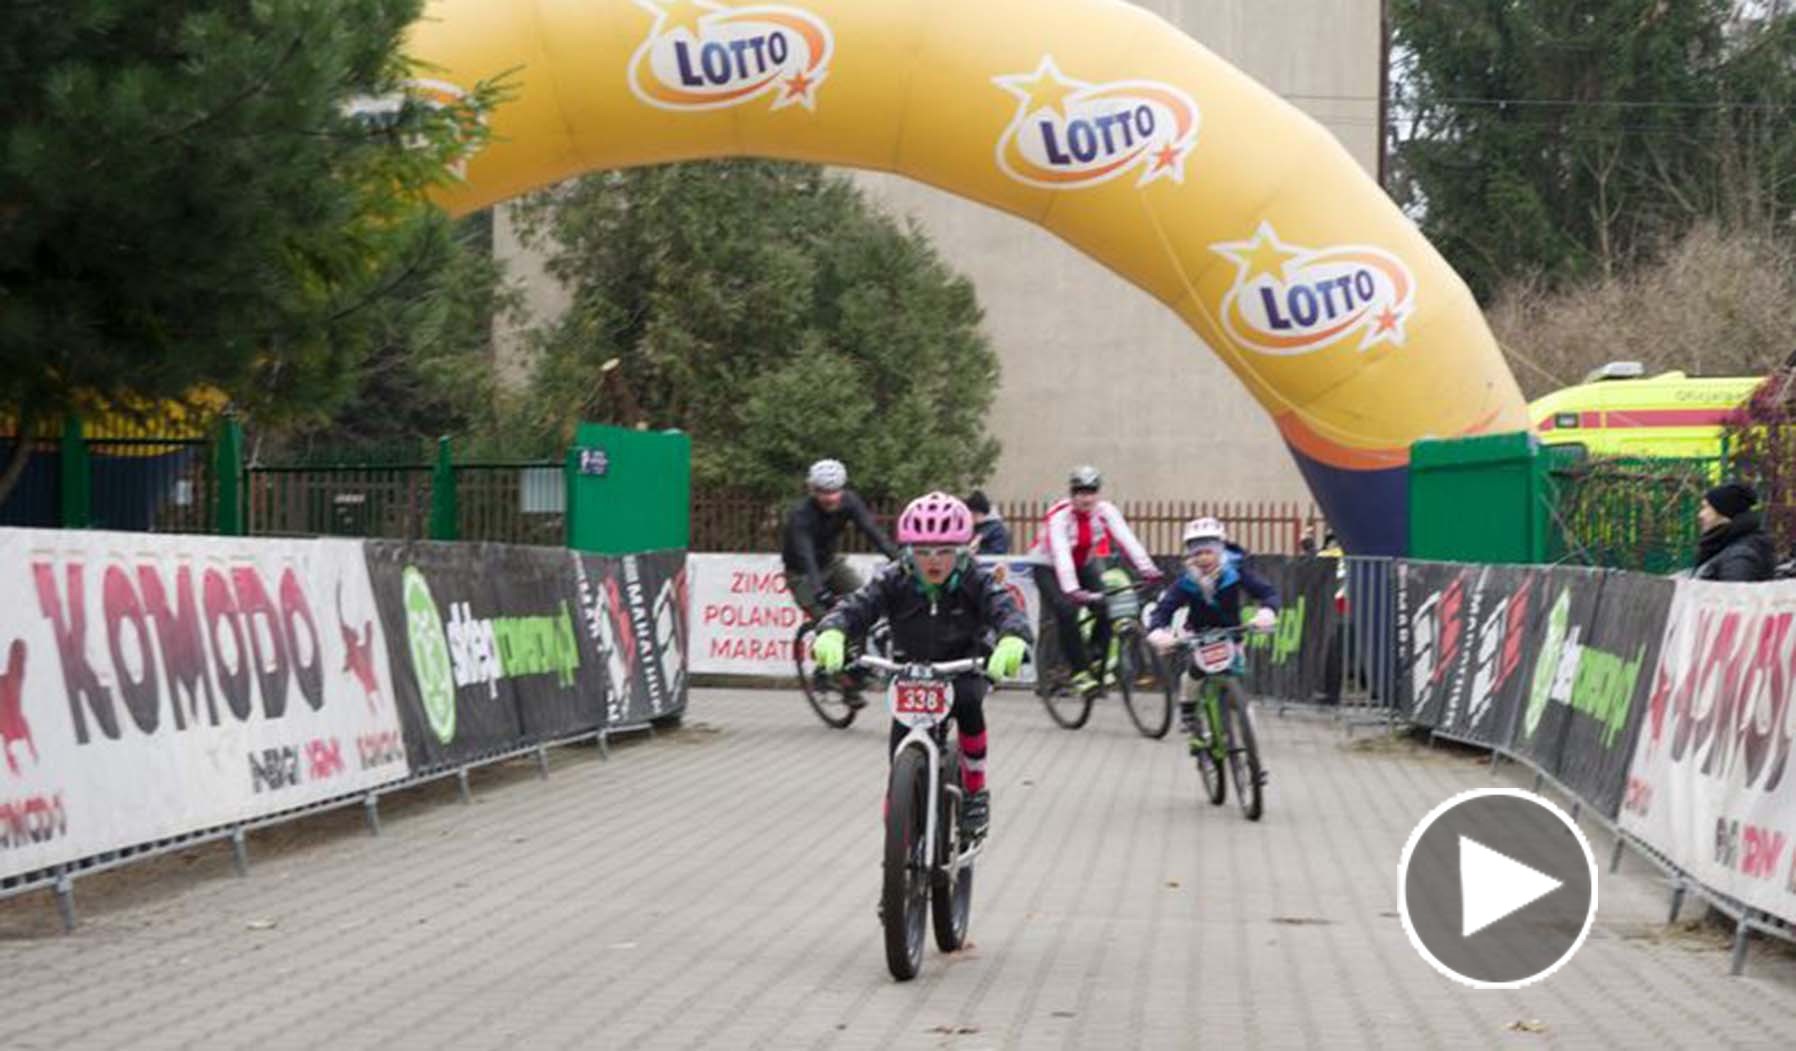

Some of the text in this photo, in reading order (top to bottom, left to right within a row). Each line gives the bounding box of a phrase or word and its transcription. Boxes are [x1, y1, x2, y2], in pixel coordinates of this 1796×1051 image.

[674, 31, 787, 86] LOTTO
[1041, 105, 1155, 165] LOTTO
[1261, 269, 1374, 330] LOTTO
[704, 604, 797, 628] POLAND
[32, 561, 324, 745] KOMODO
[903, 688, 939, 711] 338
